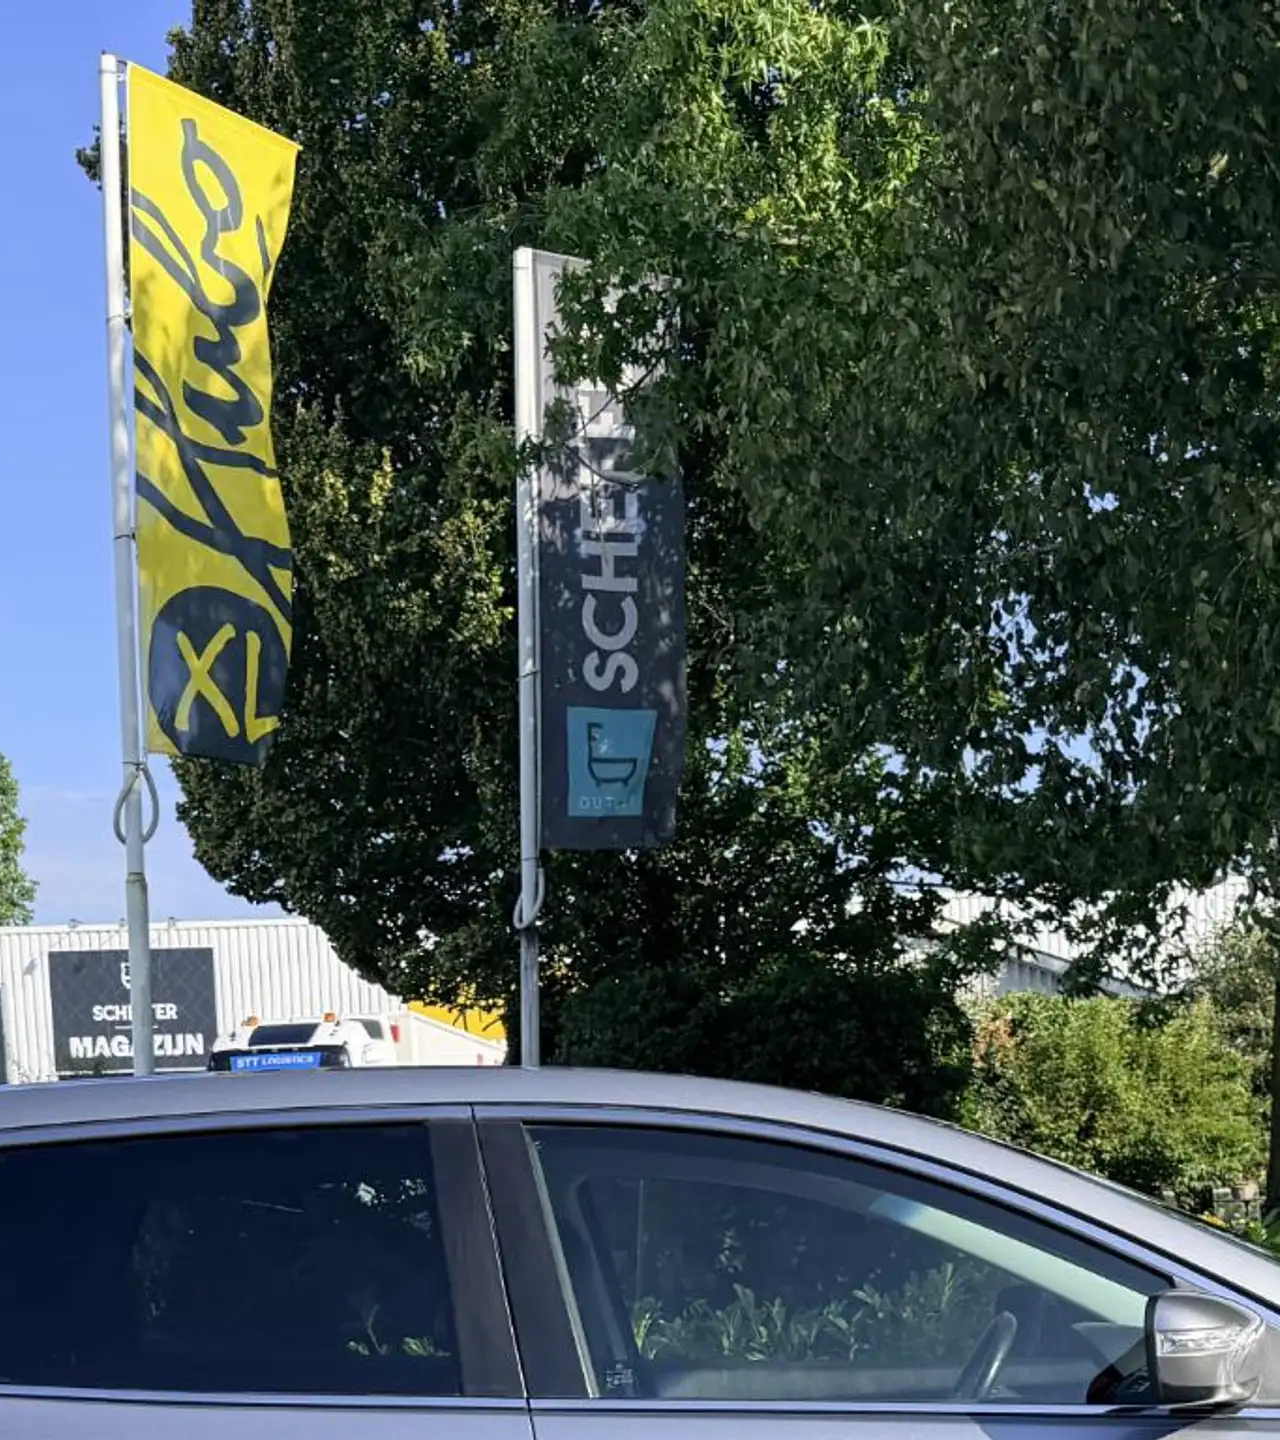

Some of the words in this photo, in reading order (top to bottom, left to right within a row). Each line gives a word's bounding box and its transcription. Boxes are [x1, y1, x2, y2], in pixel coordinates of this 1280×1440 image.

[175, 623, 280, 743] XL
[92, 1003, 178, 1021] SCHER
[69, 1033, 204, 1058] MAGZIJN
